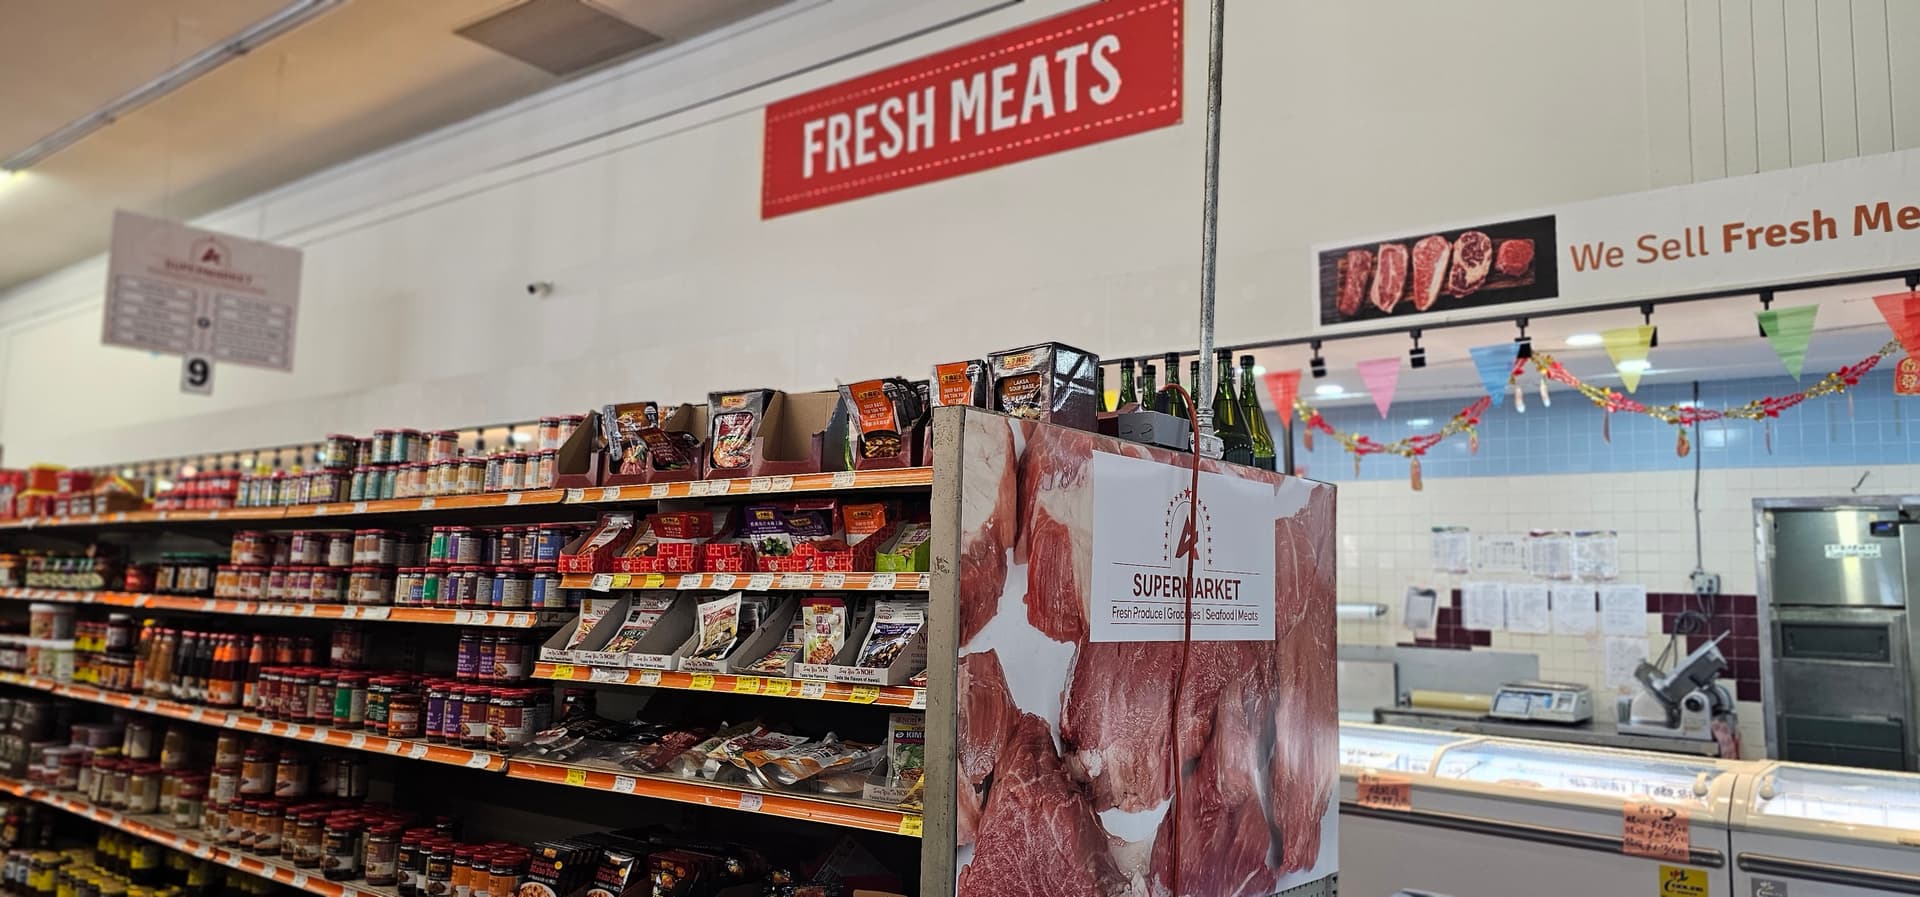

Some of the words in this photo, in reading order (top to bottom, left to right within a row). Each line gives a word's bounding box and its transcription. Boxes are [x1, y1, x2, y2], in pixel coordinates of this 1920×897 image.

[802, 85, 936, 179] FRESH
[949, 34, 1122, 143] MEATS
[1570, 241, 1624, 272] We
[1636, 226, 1710, 266] Sell
[1721, 209, 1838, 253] Fresh
[1853, 201, 1920, 239] Me
[188, 358, 210, 387] 9
[1112, 605, 1132, 619] Fresh
[1133, 606, 1163, 620] Produce
[1167, 607, 1201, 620] Groces
[1206, 607, 1235, 620] Seafood
[1238, 608, 1259, 621] Meats
